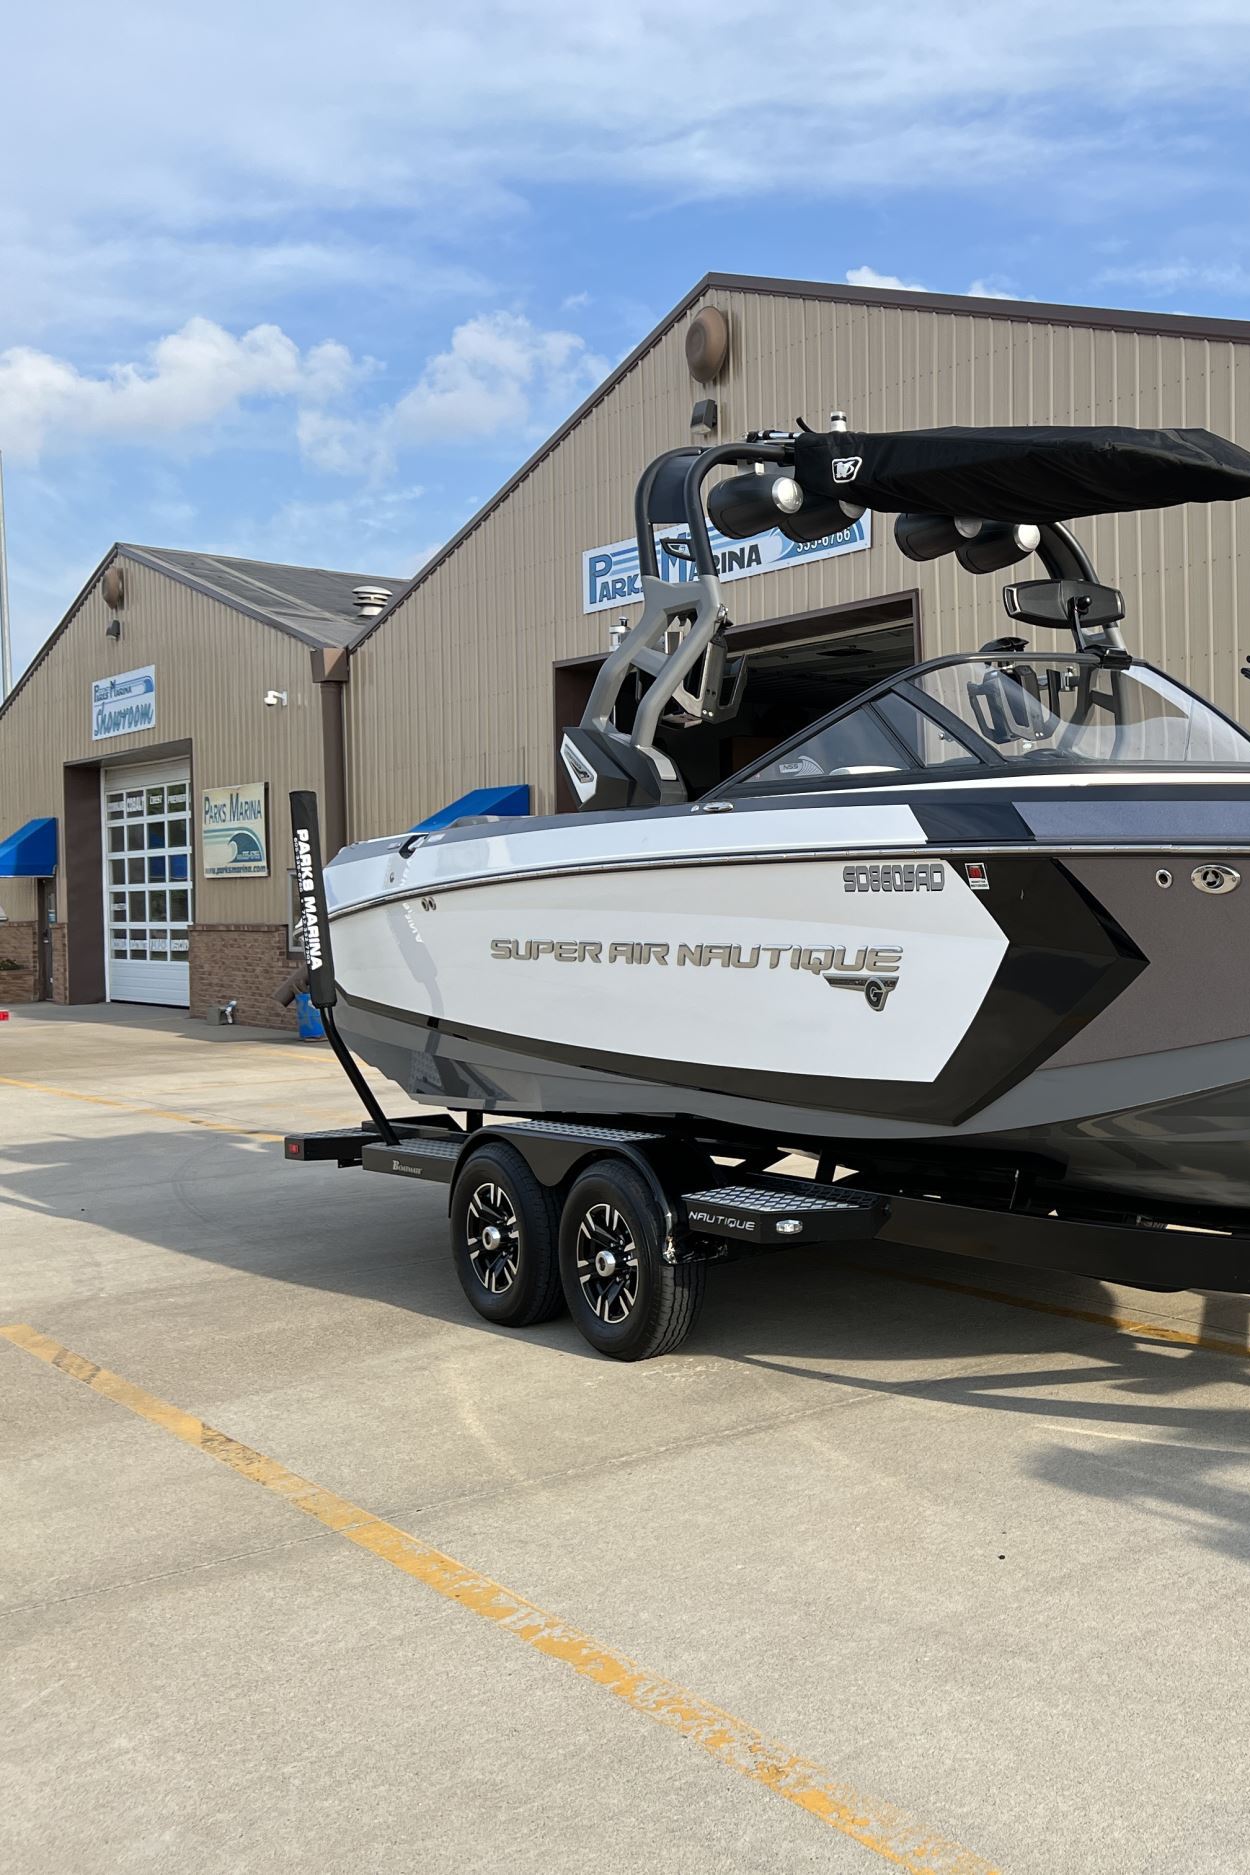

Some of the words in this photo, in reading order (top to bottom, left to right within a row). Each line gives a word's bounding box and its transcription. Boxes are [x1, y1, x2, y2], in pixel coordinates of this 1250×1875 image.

[589, 554, 643, 604] PARK
[204, 796, 226, 824] PARKS
[229, 793, 262, 822] MARINA
[297, 829, 314, 891] PARKS
[304, 896, 323, 970] MARINA
[491, 939, 602, 963] SUPER
[608, 941, 669, 965] AIR
[677, 944, 902, 975] NAUTIQUE
[688, 1211, 756, 1231] NAUTIQUE
